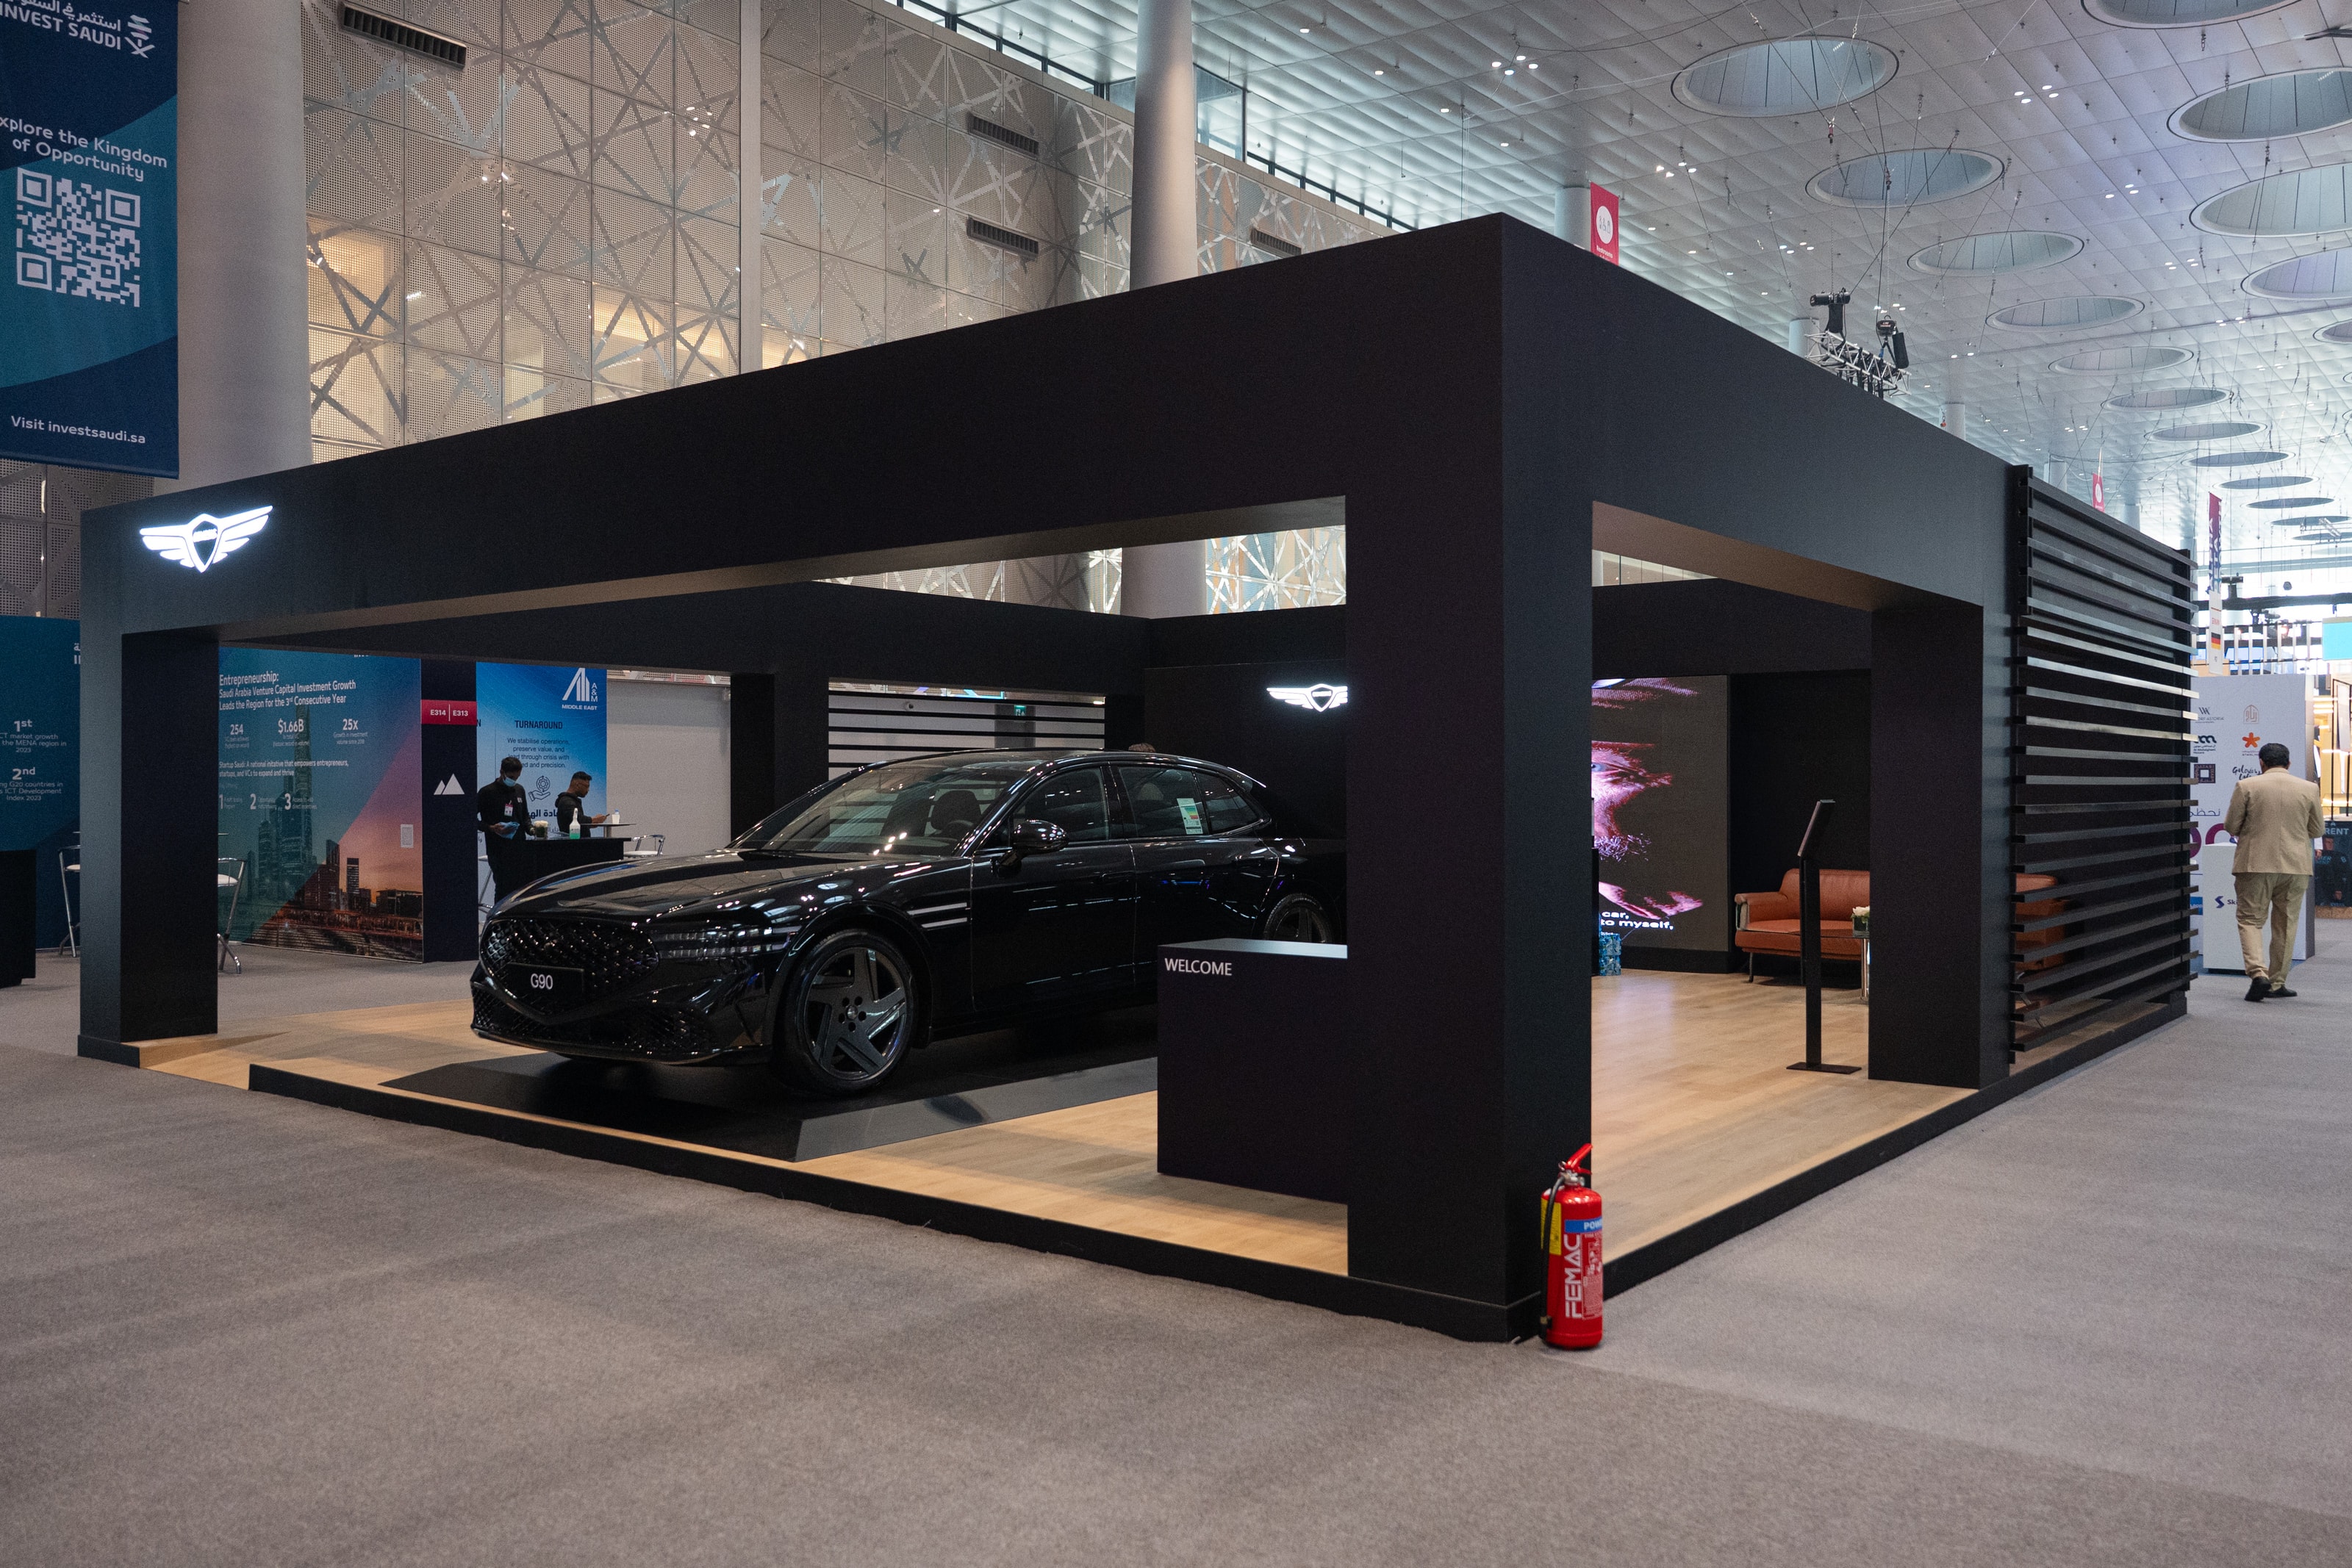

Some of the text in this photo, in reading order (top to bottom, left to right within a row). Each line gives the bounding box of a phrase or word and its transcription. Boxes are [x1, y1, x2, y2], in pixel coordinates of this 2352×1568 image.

[62, 2, 75, 21] في
[0, 1, 121, 50] INVEST SAUDI
[0, 117, 168, 168] xplore the Kingdom
[12, 138, 144, 182] of Opportunity
[11, 415, 146, 444] Visit investsaudi.sa
[219, 671, 279, 686] Entrepreneurship:
[219, 680, 356, 698] Saudi Arabia Venture Capital Investment Growth
[219, 700, 234, 711] Leads
[236, 700, 245, 709] the
[246, 699, 264, 711] Region
[275, 697, 284, 707] the
[294, 694, 331, 705] Consecutive
[332, 694, 346, 704] Year
[14, 719, 32, 732] 1st
[230, 724, 243, 735] 254
[278, 718, 304, 734] $1.66B
[343, 719, 358, 730] 25x
[515, 720, 563, 730] TURNAROUND
[12, 766, 36, 780] 2nd
[219, 794, 223, 809] 1
[250, 794, 257, 810] 2
[284, 793, 291, 810] 3
[1602, 911, 1629, 919] car,
[1618, 920, 1674, 930] myself,
[1164, 957, 1232, 976] WELCOME
[531, 973, 553, 990] G90
[1584, 1220, 1602, 1230] POW
[1563, 1234, 1582, 1318] FEMAC
